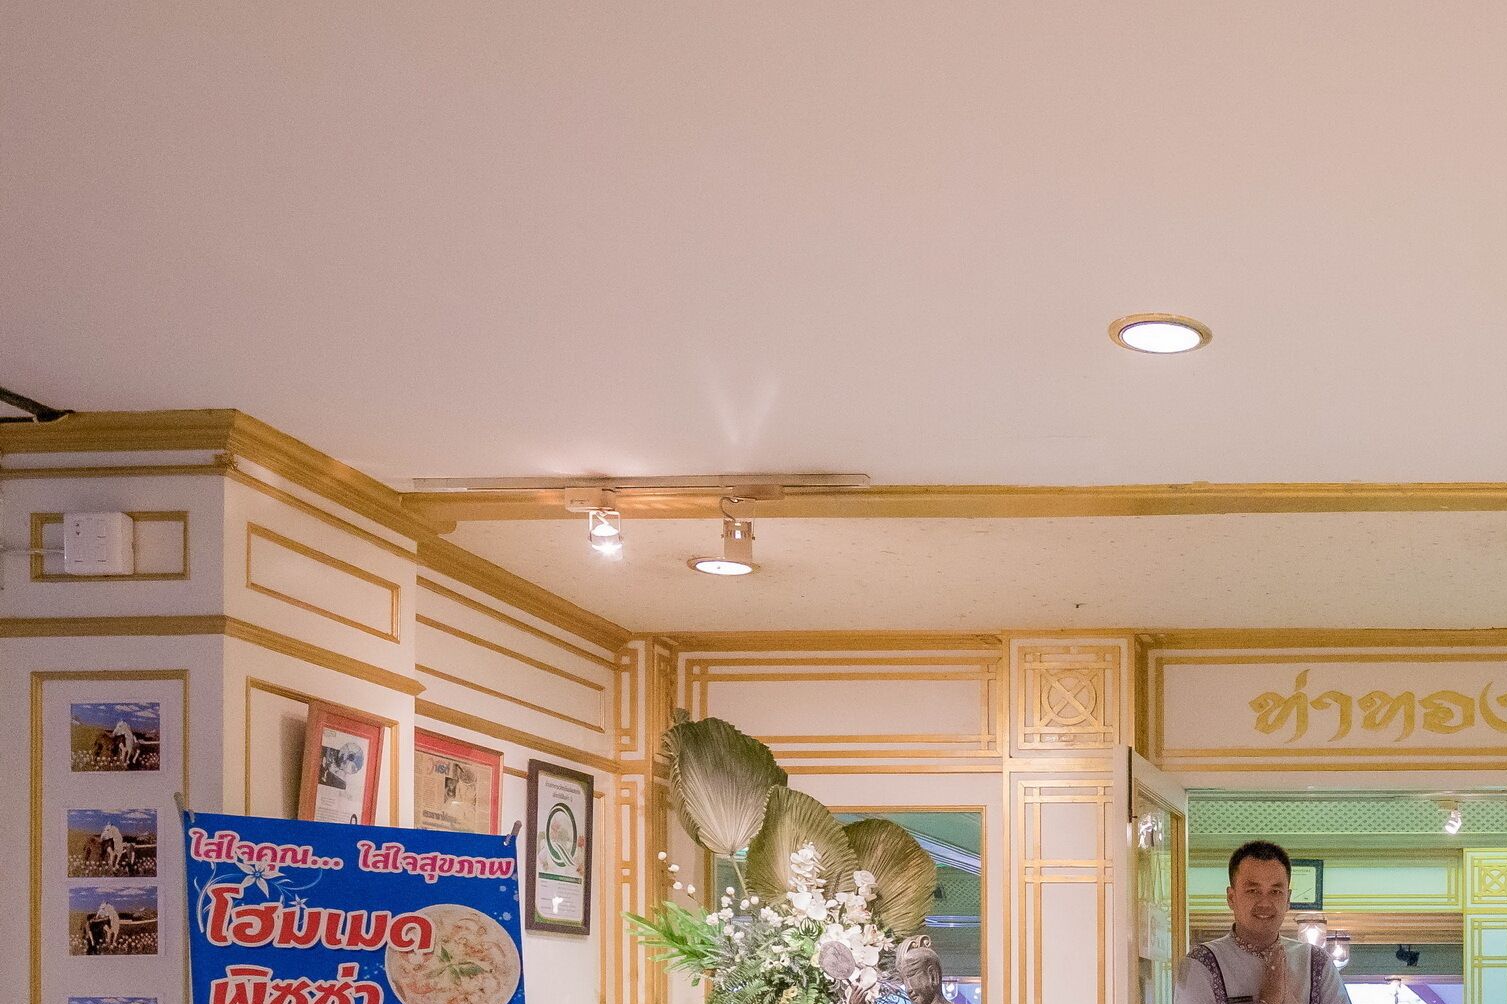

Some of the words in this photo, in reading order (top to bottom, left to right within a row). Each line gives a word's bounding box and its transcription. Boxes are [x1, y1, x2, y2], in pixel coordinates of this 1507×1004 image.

[189, 828, 344, 872] ใส่ใจคุณ...
[357, 841, 516, 883] ใส่ใจสุขภาพ
[206, 883, 435, 952] โฮมเมด
